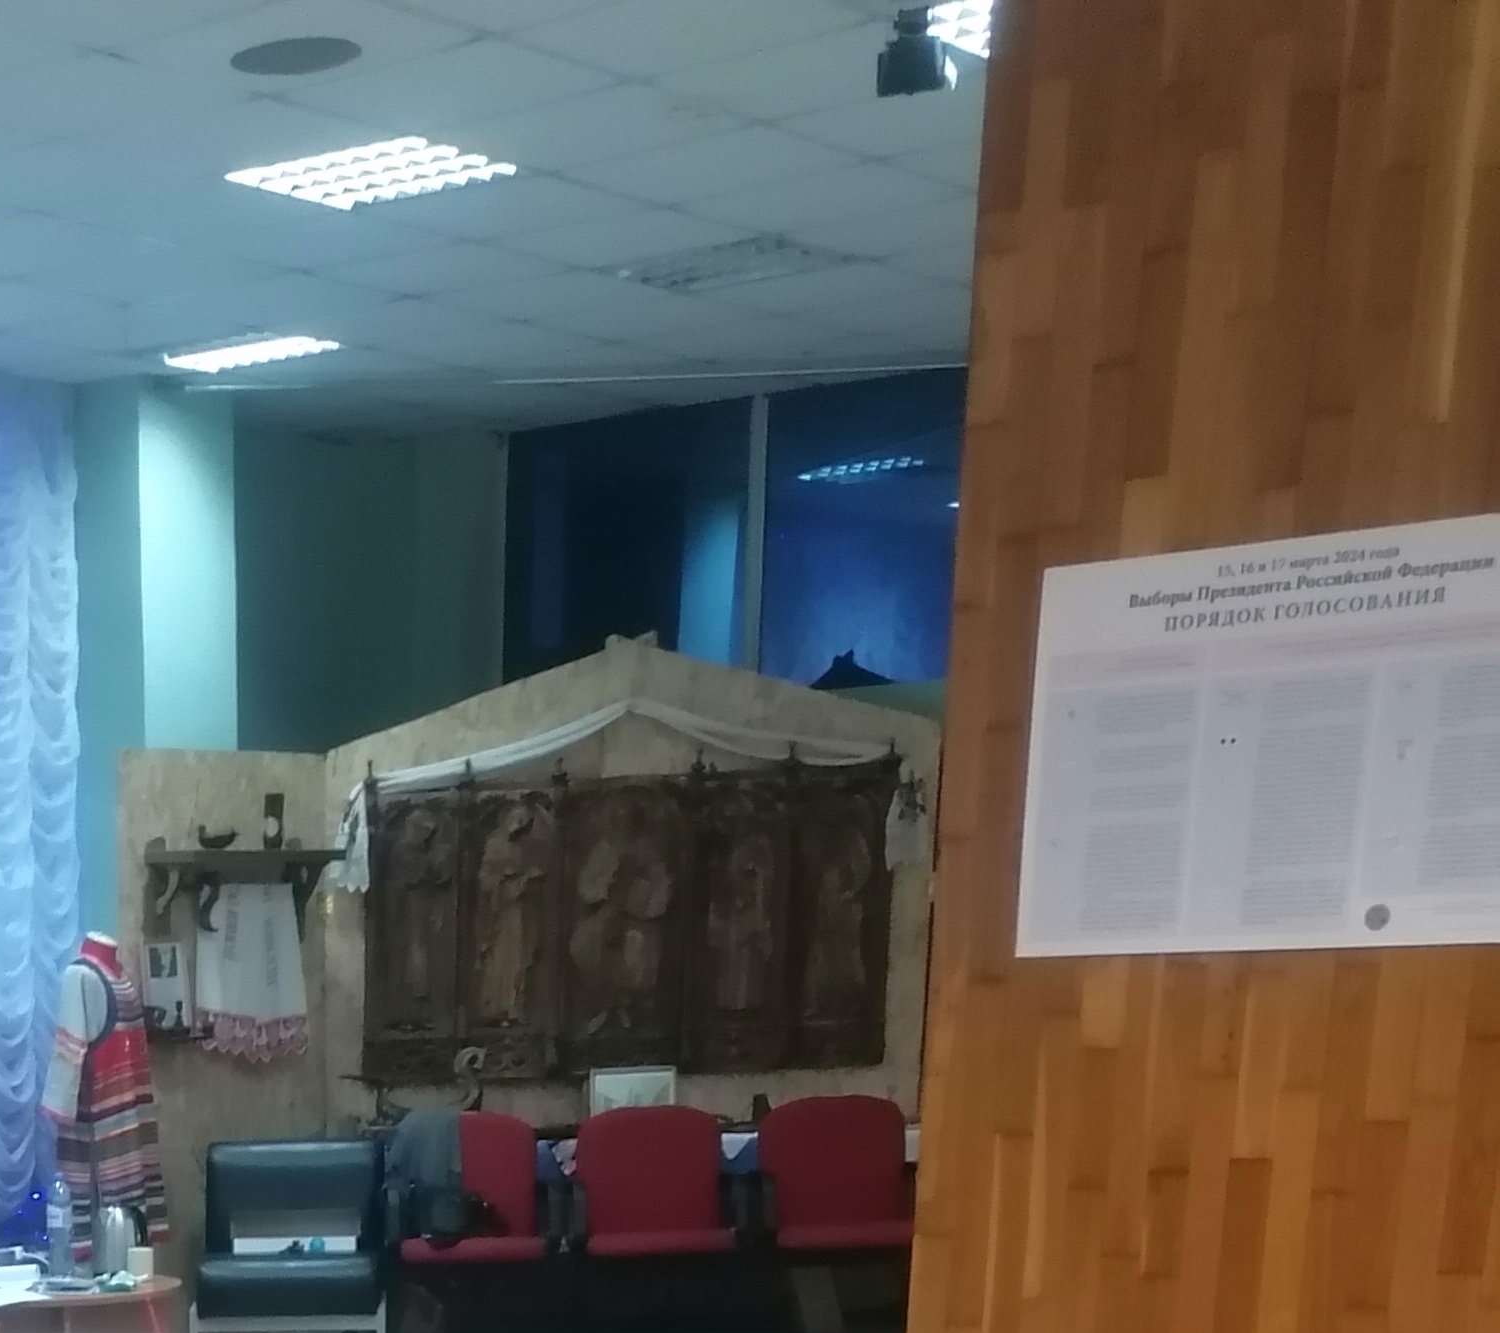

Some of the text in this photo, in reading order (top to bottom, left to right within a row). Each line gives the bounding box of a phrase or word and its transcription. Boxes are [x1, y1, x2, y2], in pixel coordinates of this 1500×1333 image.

[1129, 557, 1495, 608] Выборы Президента Российской Федерации
[1241, 562, 1255, 574] 16
[1258, 563, 1267, 572] и
[1271, 558, 1286, 571] 17
[1290, 556, 1329, 571] марта
[1334, 549, 1366, 564] 2024
[1369, 547, 1400, 559] года
[1164, 586, 1446, 632] ПОРЯДОК ГОЛОСОВАНИЯ
